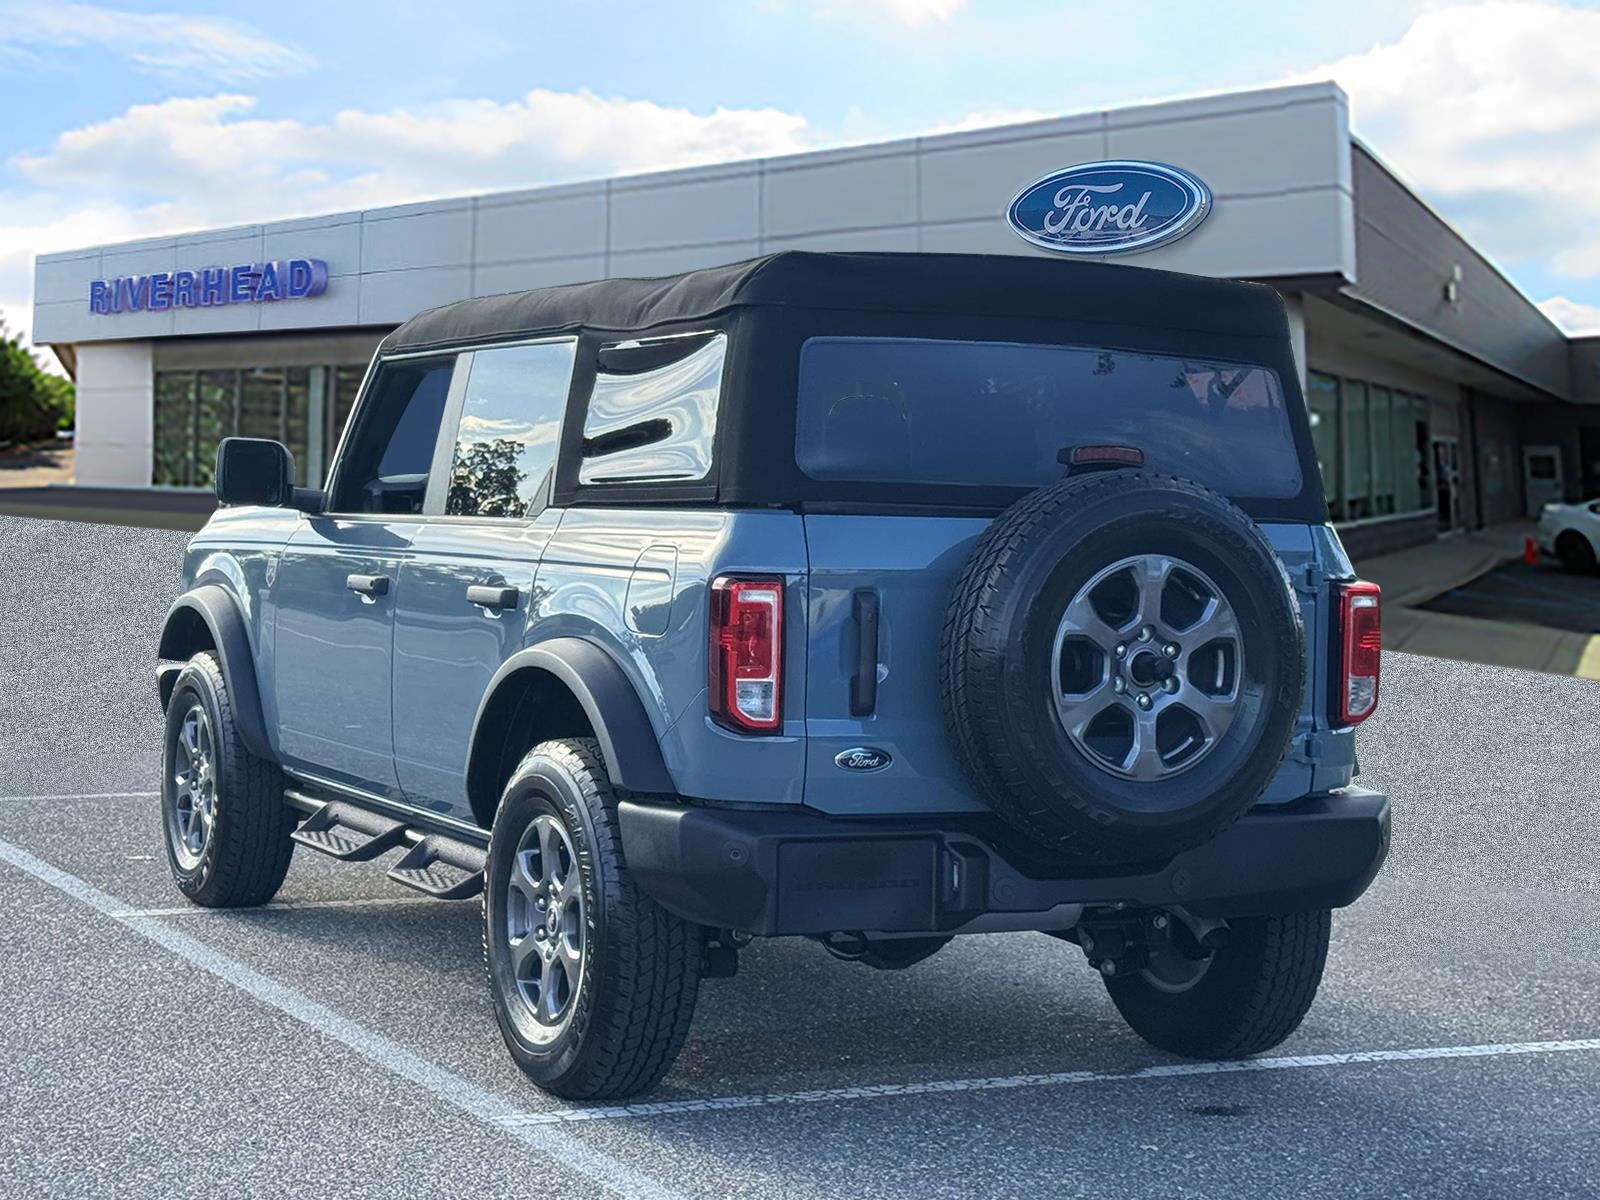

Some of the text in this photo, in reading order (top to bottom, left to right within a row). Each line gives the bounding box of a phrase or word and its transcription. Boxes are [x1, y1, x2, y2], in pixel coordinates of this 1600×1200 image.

[1043, 182, 1152, 234] Ford
[89, 258, 325, 315] RIVERHEAD
[848, 752, 880, 768] Ford
